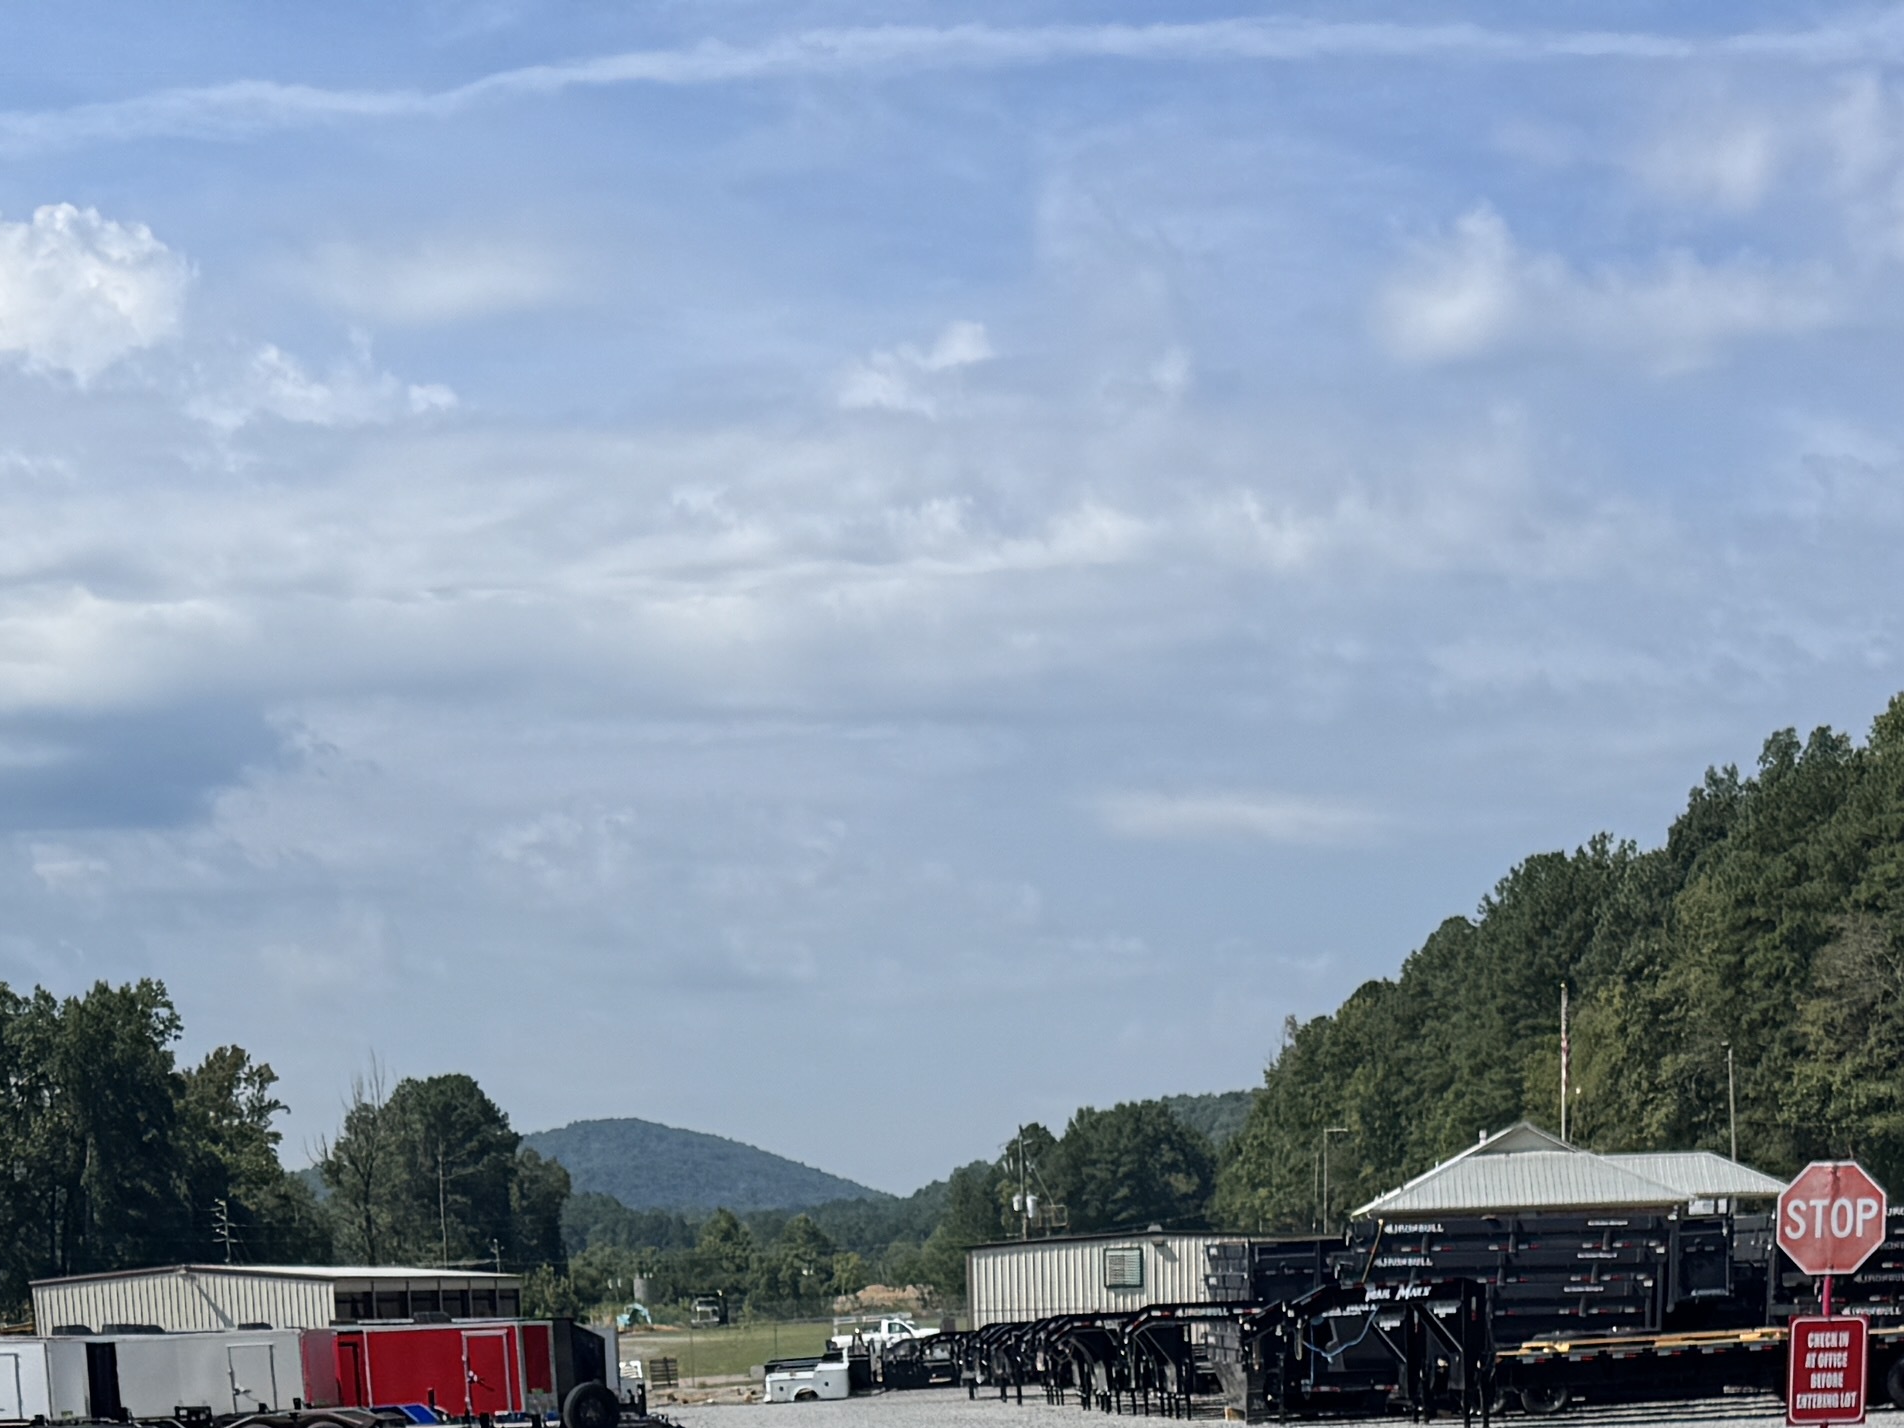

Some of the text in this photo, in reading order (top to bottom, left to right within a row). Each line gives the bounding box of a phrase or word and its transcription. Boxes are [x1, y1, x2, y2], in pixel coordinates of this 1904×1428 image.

[1785, 1198, 1878, 1239] STOP
[1808, 1332, 1850, 1348] CHECK IN
[1805, 1351, 1848, 1368] AT OFFICE
[1810, 1372, 1844, 1389] BEFORE
[1797, 1392, 1857, 1409] ENTERING LOT
